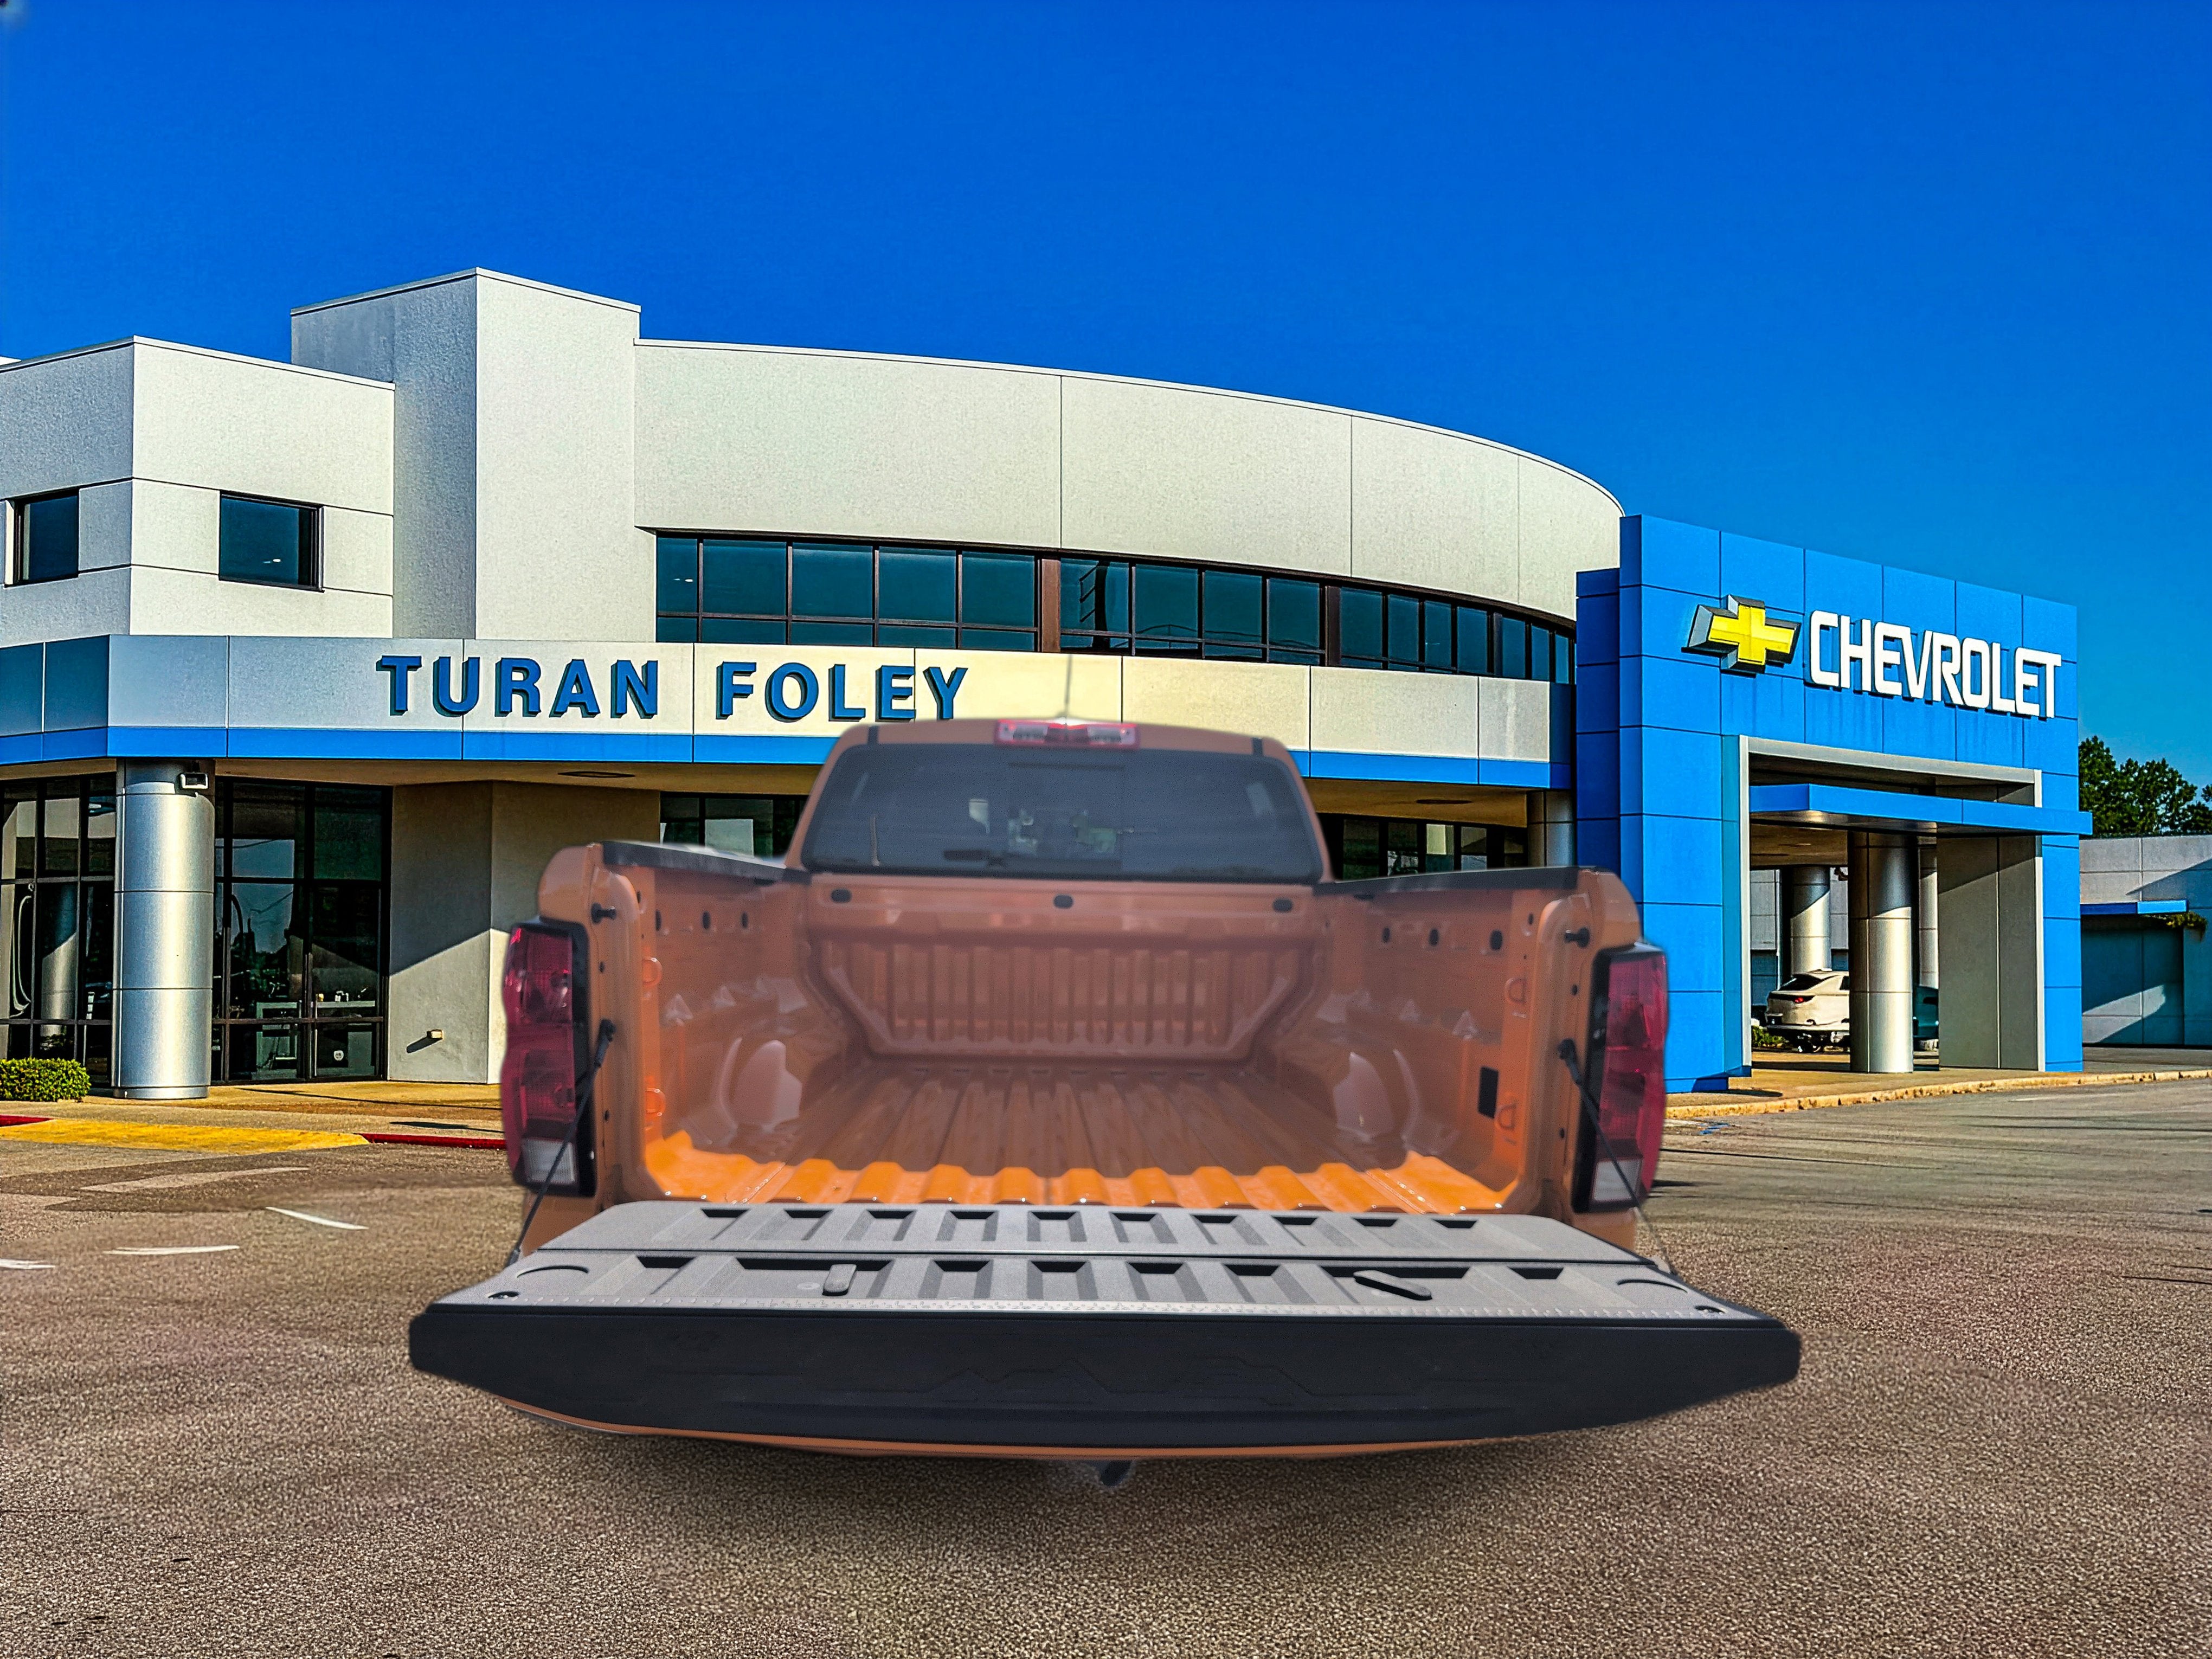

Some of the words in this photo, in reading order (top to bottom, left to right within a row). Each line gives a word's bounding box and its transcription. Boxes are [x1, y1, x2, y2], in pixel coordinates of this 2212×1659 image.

[376, 655, 659, 719] TURAN
[715, 661, 968, 721] FOLEY
[1810, 610, 2062, 719] CHEVROLET
